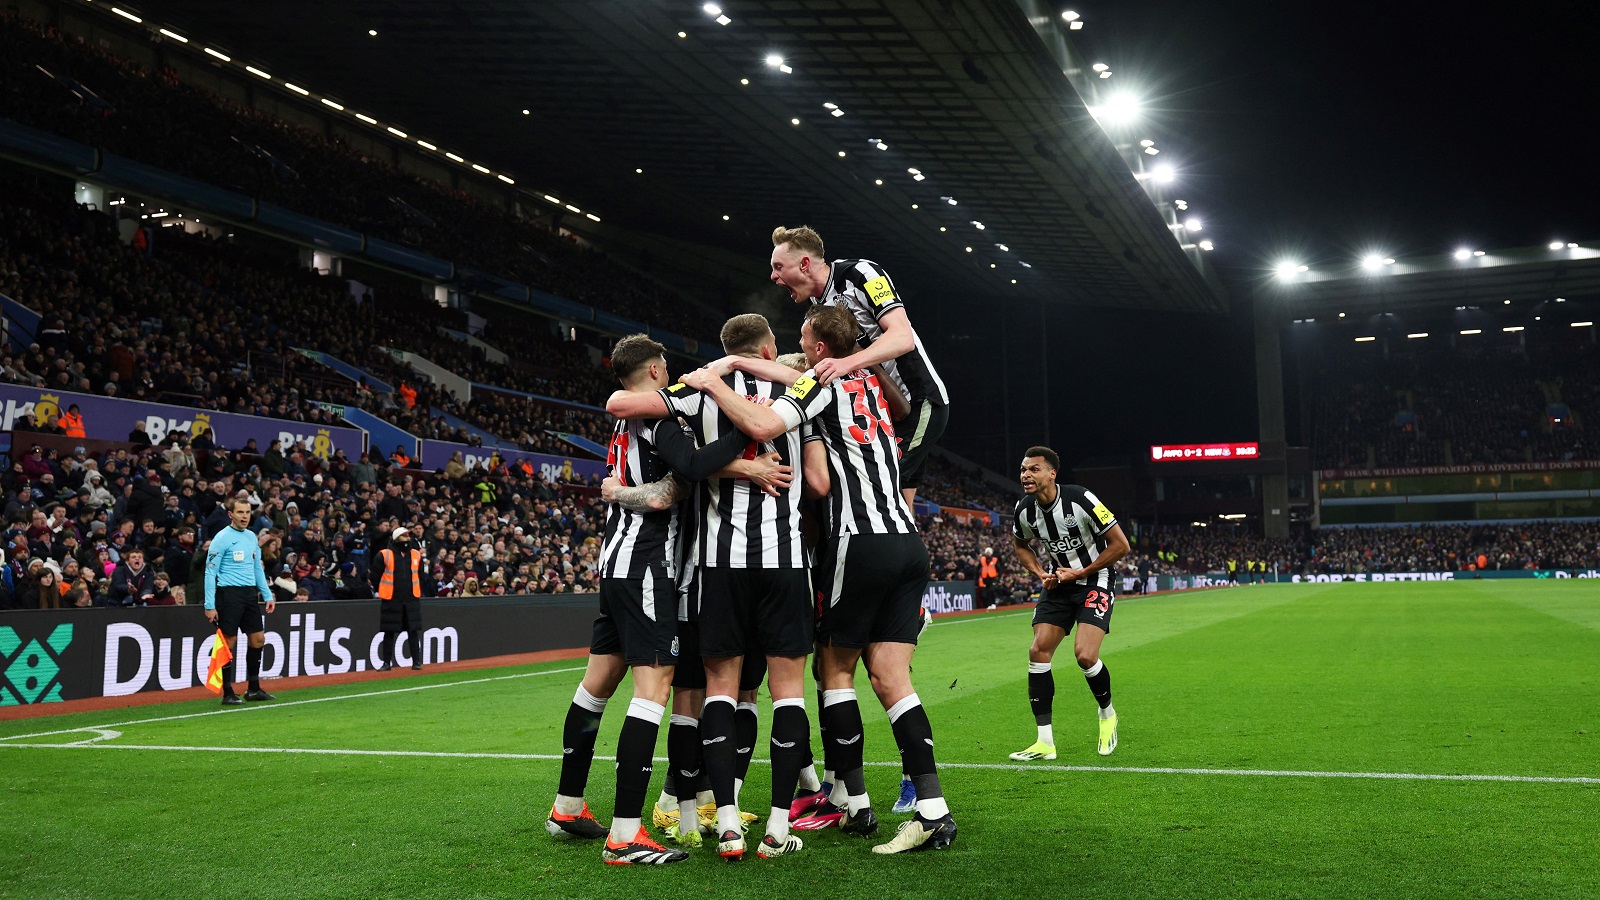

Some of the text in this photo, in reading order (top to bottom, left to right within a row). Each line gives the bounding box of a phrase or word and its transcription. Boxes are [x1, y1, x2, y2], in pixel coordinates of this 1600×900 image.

[841, 374, 895, 445] 33
[1422, 465, 1470, 474] PREPARED
[1472, 464, 1486, 473] TO
[1549, 460, 1581, 470] DOWN
[922, 586, 972, 613] elbits.com
[1084, 590, 1110, 612] 23
